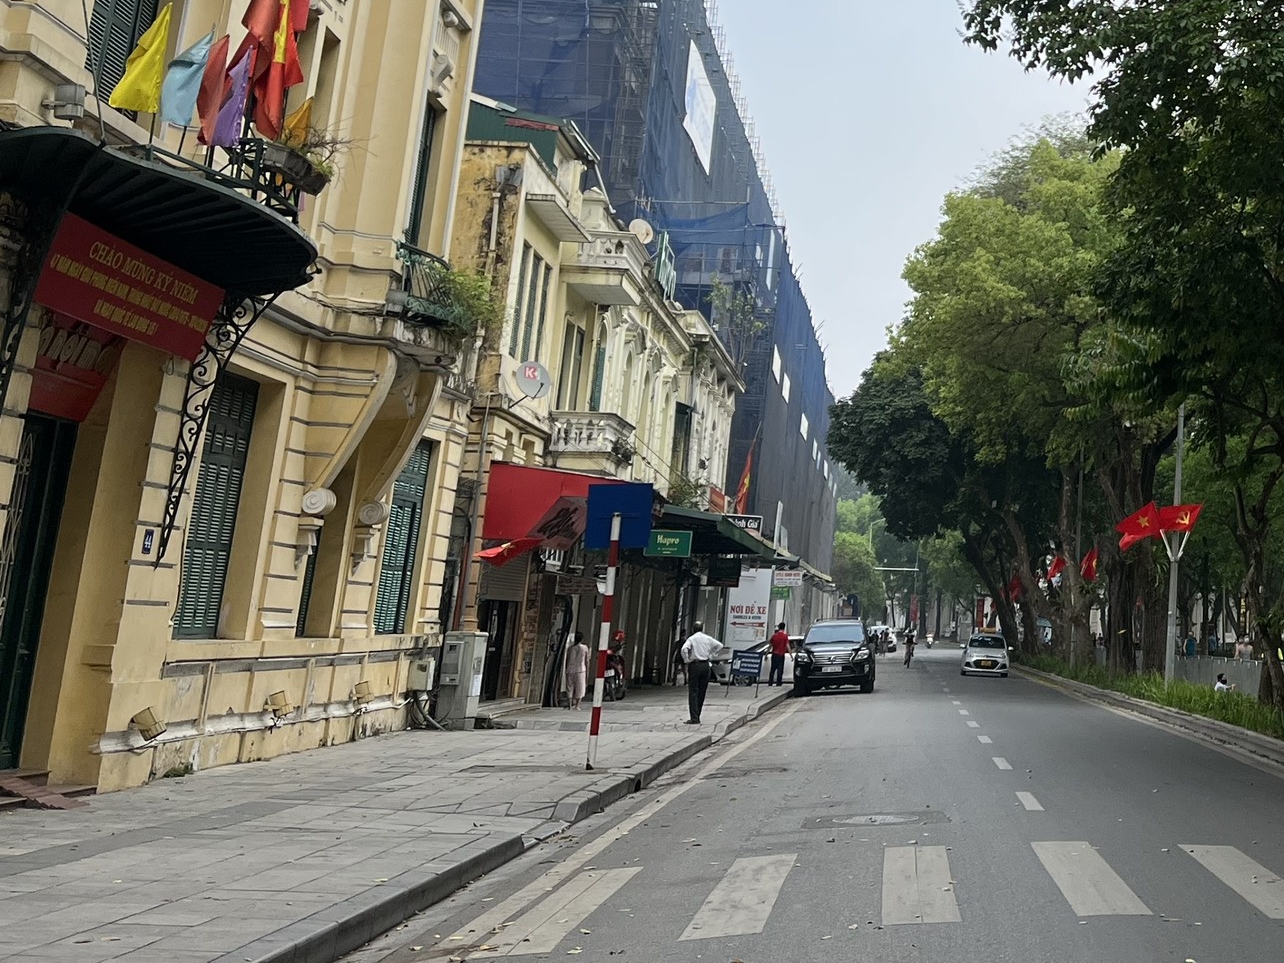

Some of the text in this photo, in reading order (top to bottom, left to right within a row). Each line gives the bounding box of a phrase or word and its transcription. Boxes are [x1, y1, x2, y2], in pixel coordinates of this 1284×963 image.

[89, 241, 123, 269] CHÀO
[169, 279, 198, 304] NIỆM
[656, 534, 680, 546] Hapro
[757, 605, 767, 615] XE
